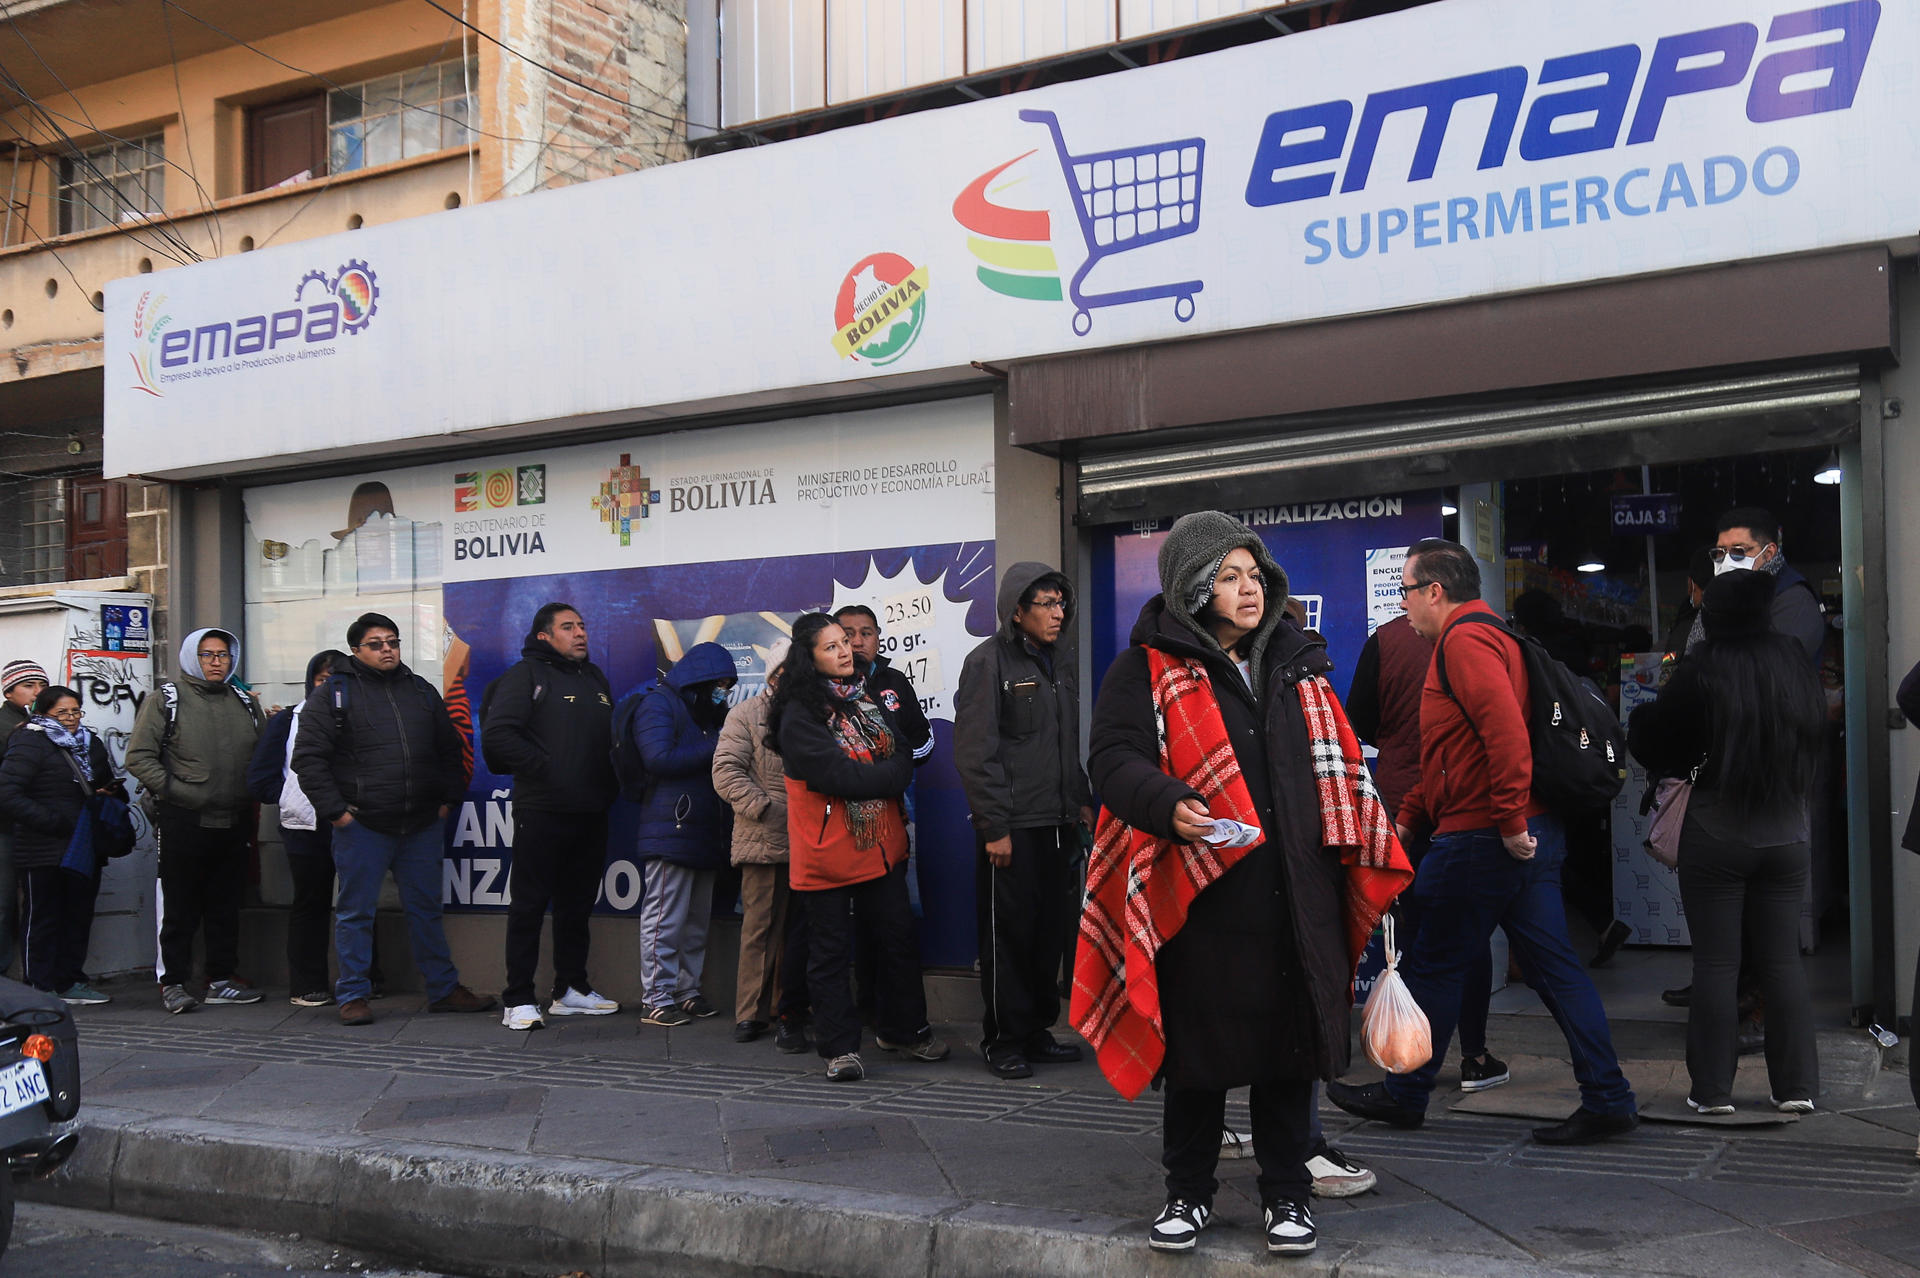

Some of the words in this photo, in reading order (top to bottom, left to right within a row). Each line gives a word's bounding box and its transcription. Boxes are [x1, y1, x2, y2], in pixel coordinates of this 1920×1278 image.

[1303, 145, 1800, 265] SUPERMERCADO
[845, 279, 921, 346] BOLIVIA
[855, 291, 878, 314] HECHO
[878, 282, 888, 296] EN
[160, 301, 340, 368] emapa
[160, 372, 191, 383] Empresa
[192, 368, 202, 378] de
[202, 365, 226, 380] Apoyo
[226, 364, 233, 372] a
[233, 362, 241, 371] la
[241, 354, 285, 369] Producción
[285, 351, 296, 362] de
[296, 345, 336, 361] Alimentos
[670, 476, 699, 487] ESTADO
[700, 469, 761, 483] PLURINACIONAL
[763, 467, 775, 477] DE
[797, 469, 861, 487] MINISTERIO
[863, 467, 878, 480] DE
[881, 459, 957, 479] DESARROLLO
[797, 483, 868, 501] PRODUCTIVO
[871, 482, 878, 495] Y
[881, 474, 944, 494] ECONOMÍA
[946, 471, 991, 488] PLURAL
[669, 478, 777, 513] BOLIVIA
[453, 515, 528, 535] BICENTENARIO
[530, 513, 547, 527] DE
[1614, 509, 1655, 526] CAJA
[1657, 509, 1666, 524] 3
[454, 531, 546, 561] BOLIVIA
[884, 595, 932, 625] 23.50
[902, 632, 927, 652] gr.
[15, 1072, 46, 1102] ANC
